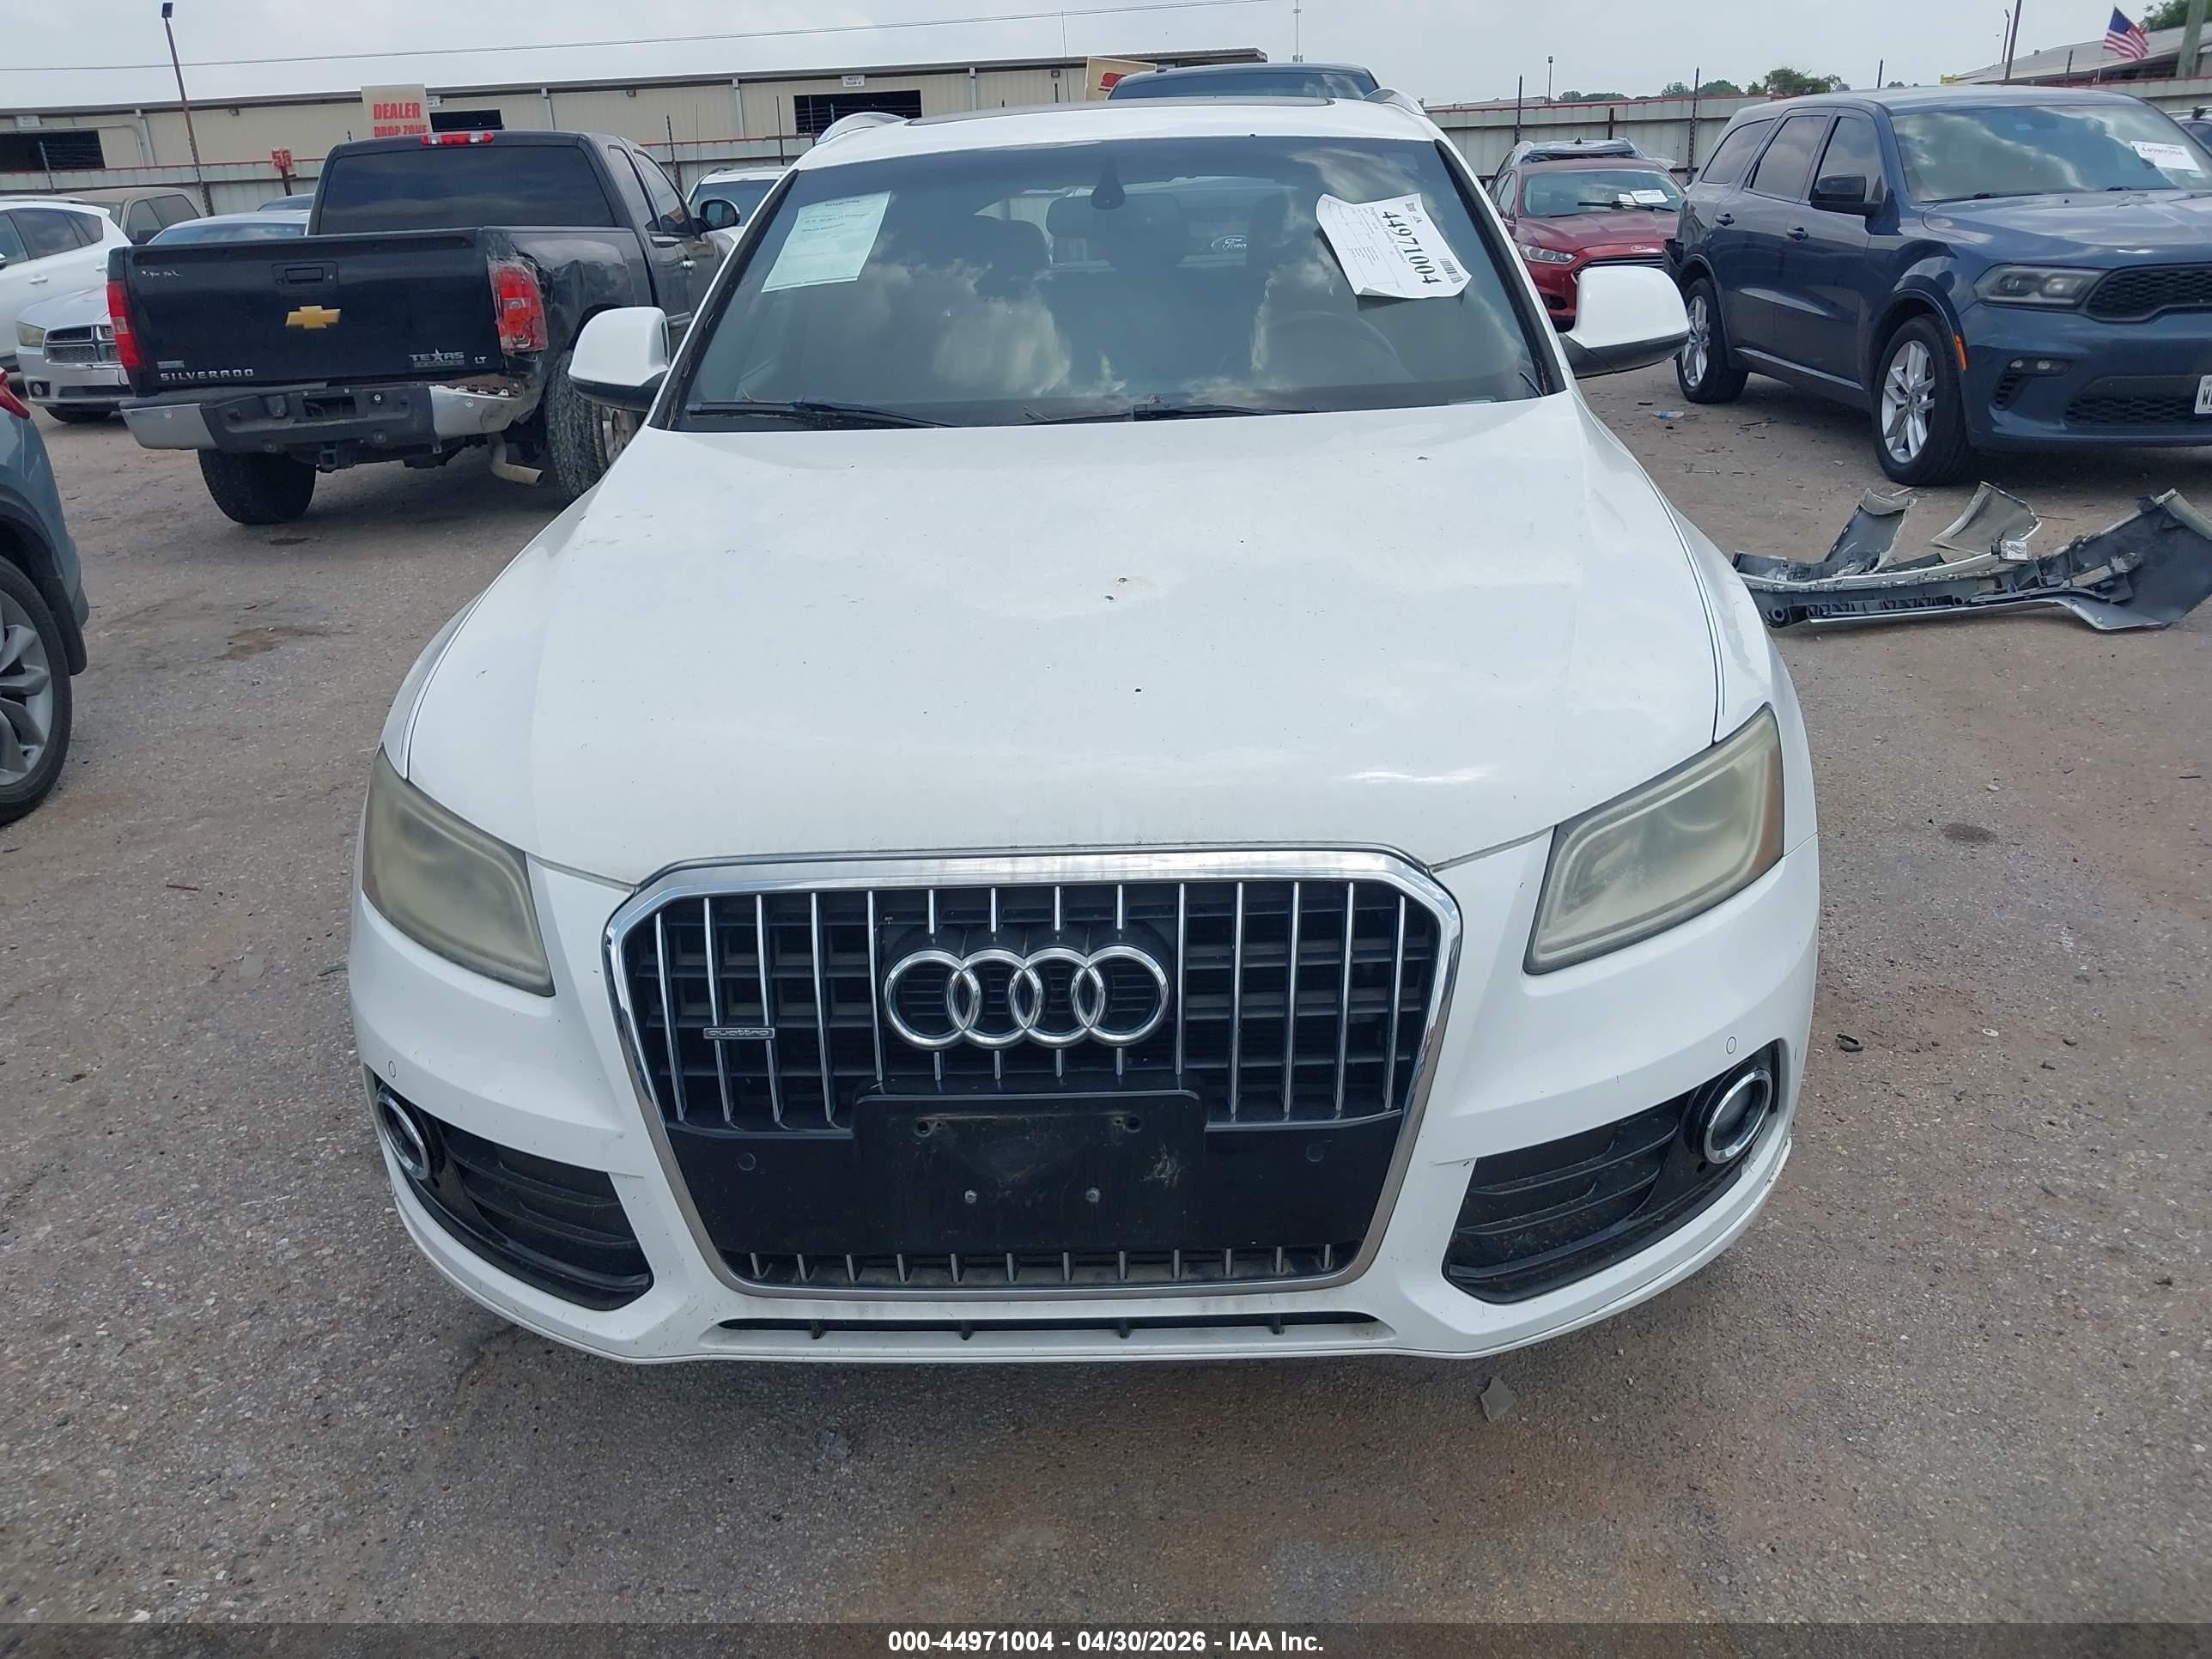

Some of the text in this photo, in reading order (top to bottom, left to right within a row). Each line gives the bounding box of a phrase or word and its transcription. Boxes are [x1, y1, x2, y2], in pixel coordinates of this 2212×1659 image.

[374, 102, 421, 119] DEALER
[374, 126, 401, 137] DROP
[1382, 211, 1443, 285] 44971004
[160, 368, 254, 380] SILVERADO
